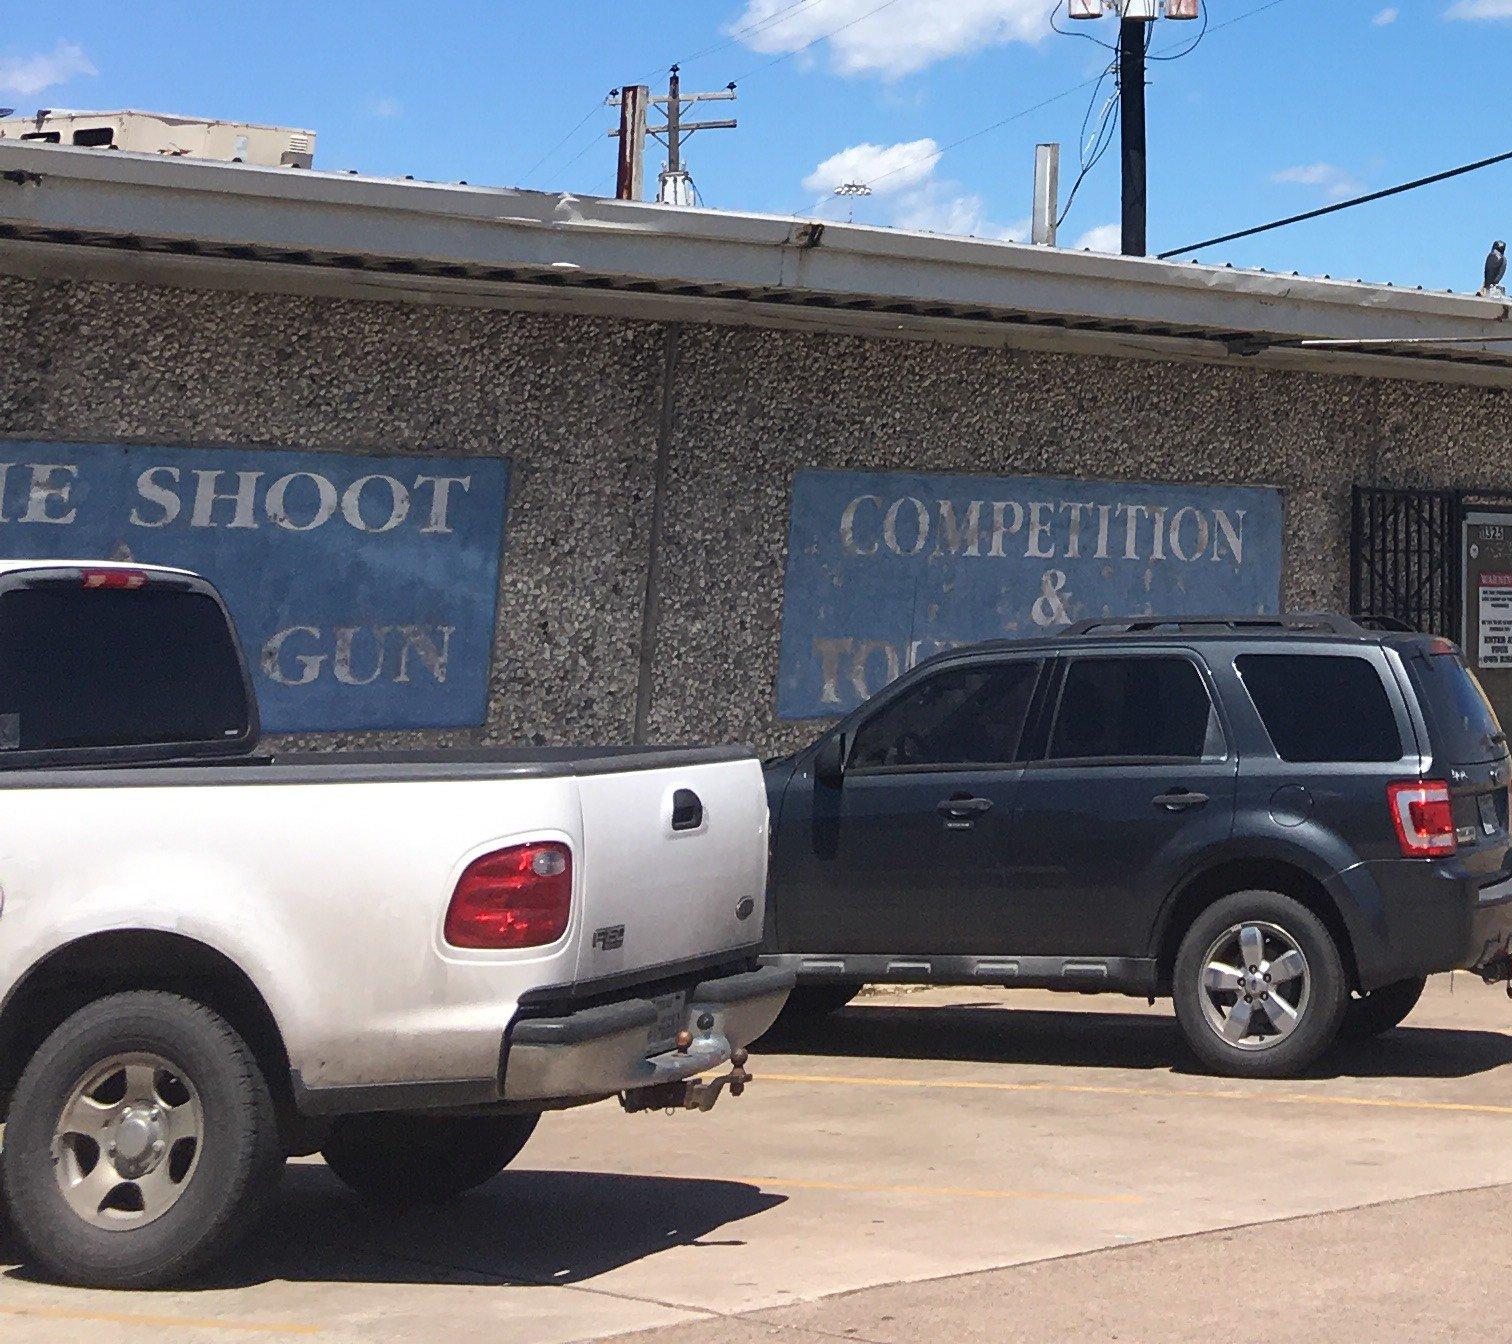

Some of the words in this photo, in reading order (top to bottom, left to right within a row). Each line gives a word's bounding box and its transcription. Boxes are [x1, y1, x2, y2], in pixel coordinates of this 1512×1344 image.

[130, 466, 470, 534] SHOOT
[839, 494, 1247, 564] COMPETITION
[1031, 569, 1073, 627] &
[261, 625, 456, 686] GUN
